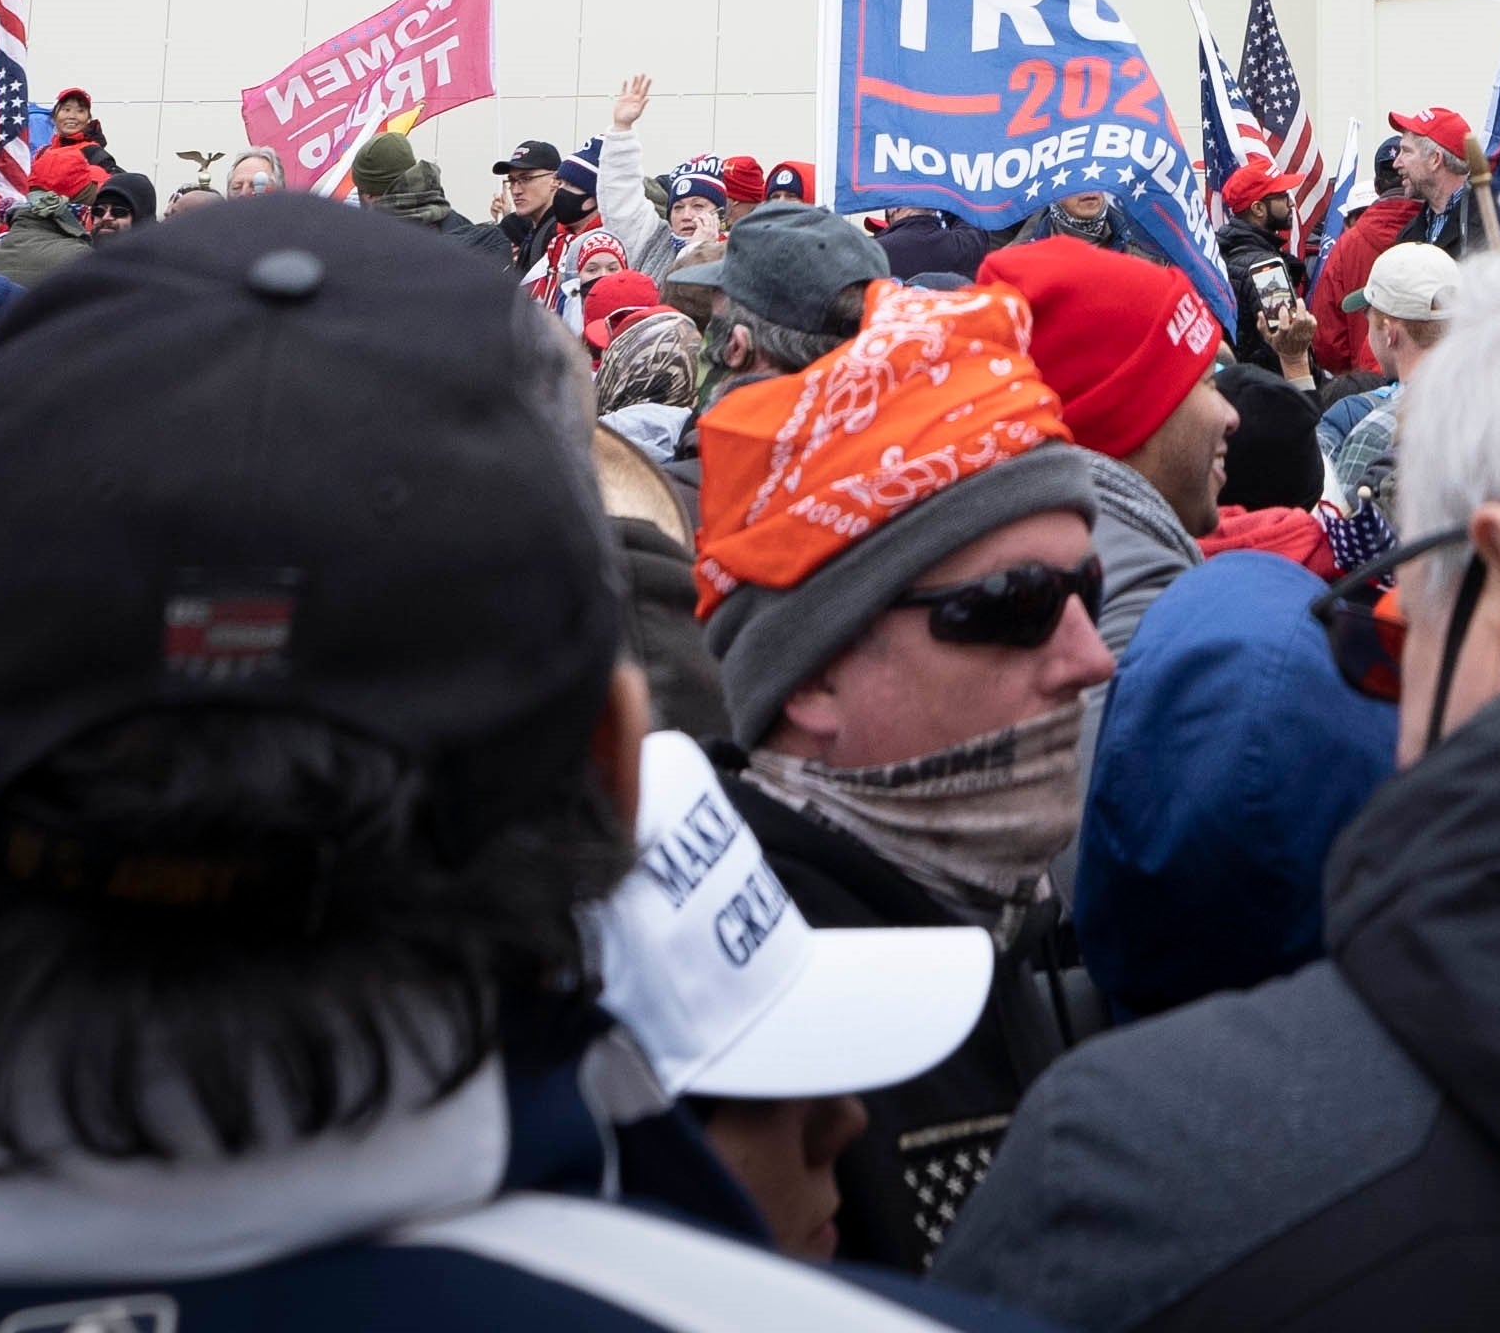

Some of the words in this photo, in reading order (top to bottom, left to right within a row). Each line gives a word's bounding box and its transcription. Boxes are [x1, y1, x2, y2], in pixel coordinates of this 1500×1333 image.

[1007, 56, 1180, 145] 202
[874, 133, 947, 173] NO
[950, 124, 1091, 192] MORE
[643, 791, 746, 910] MAKE
